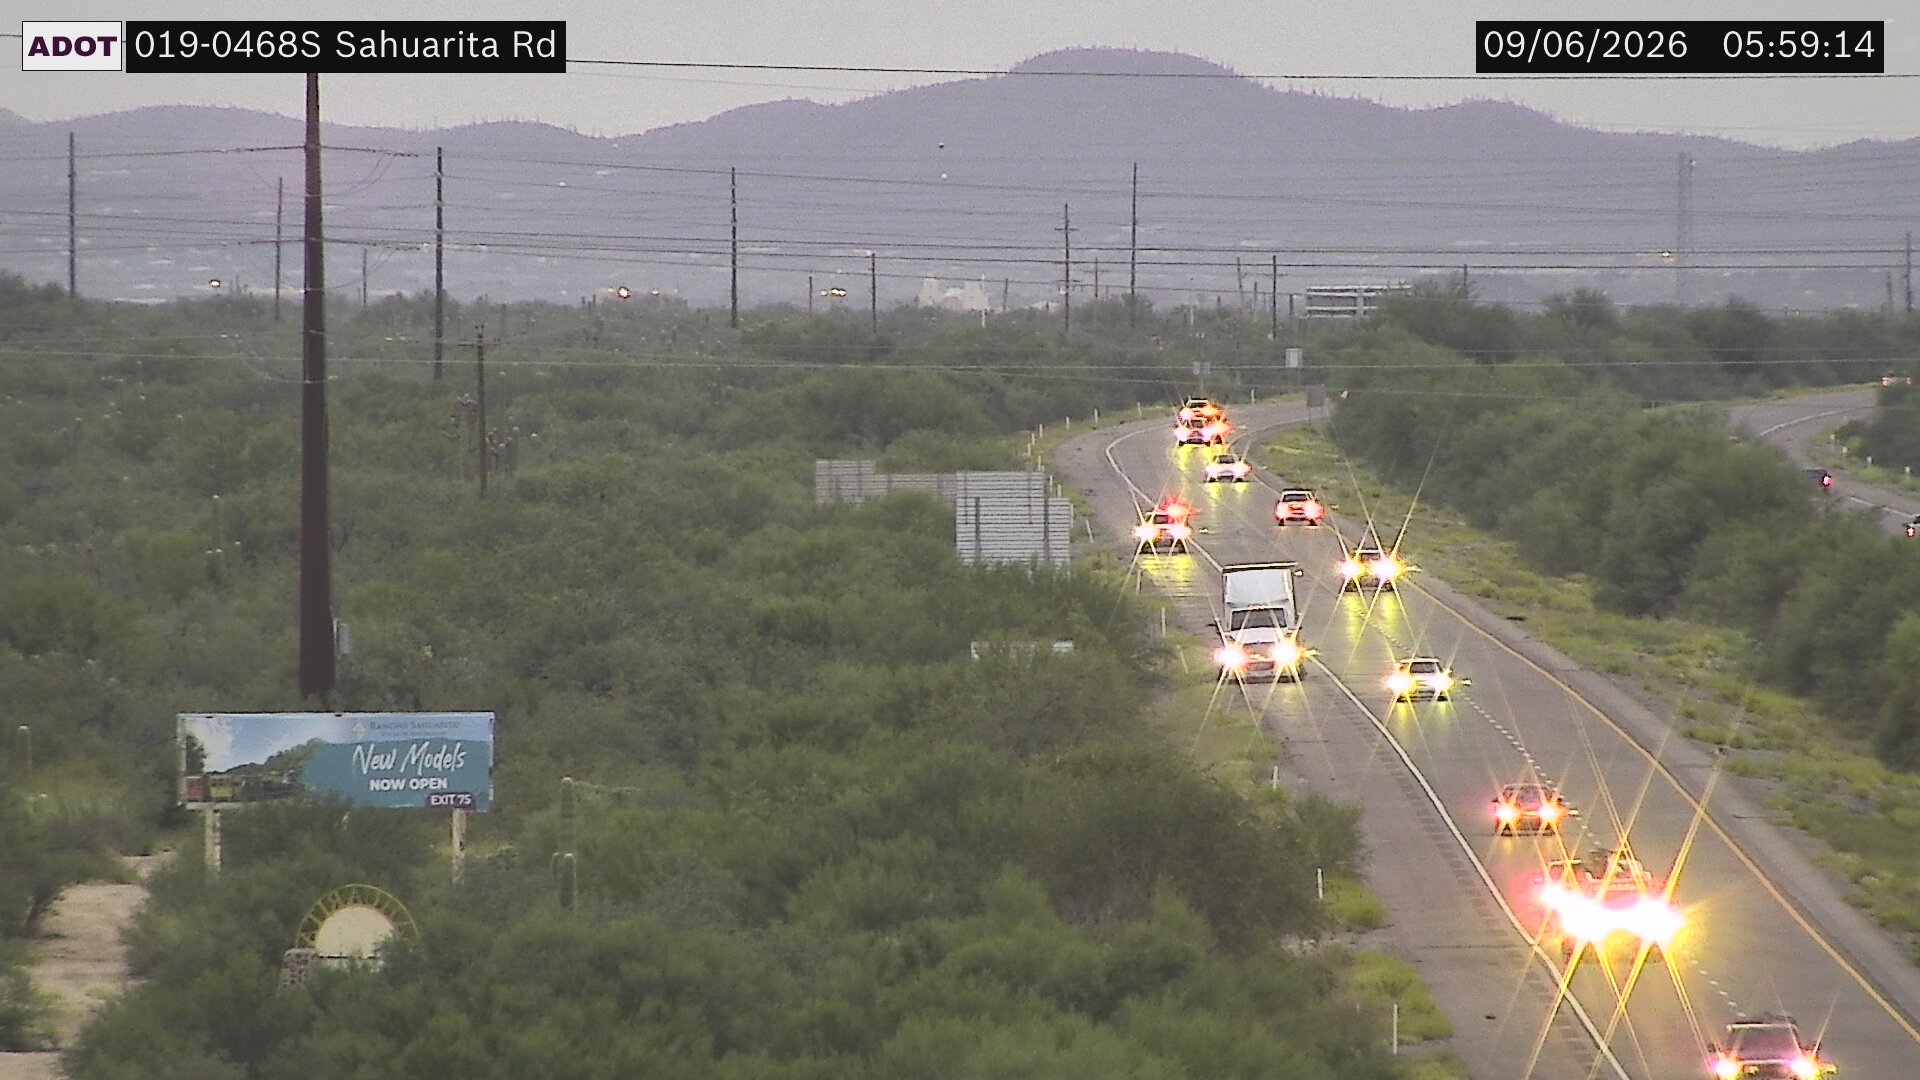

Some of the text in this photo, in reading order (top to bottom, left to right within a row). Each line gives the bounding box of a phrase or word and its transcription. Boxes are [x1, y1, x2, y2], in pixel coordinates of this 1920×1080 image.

[352, 741, 467, 775] New Models
[369, 777, 448, 791] NOW OPEN
[431, 794, 472, 806] EXIT 75
